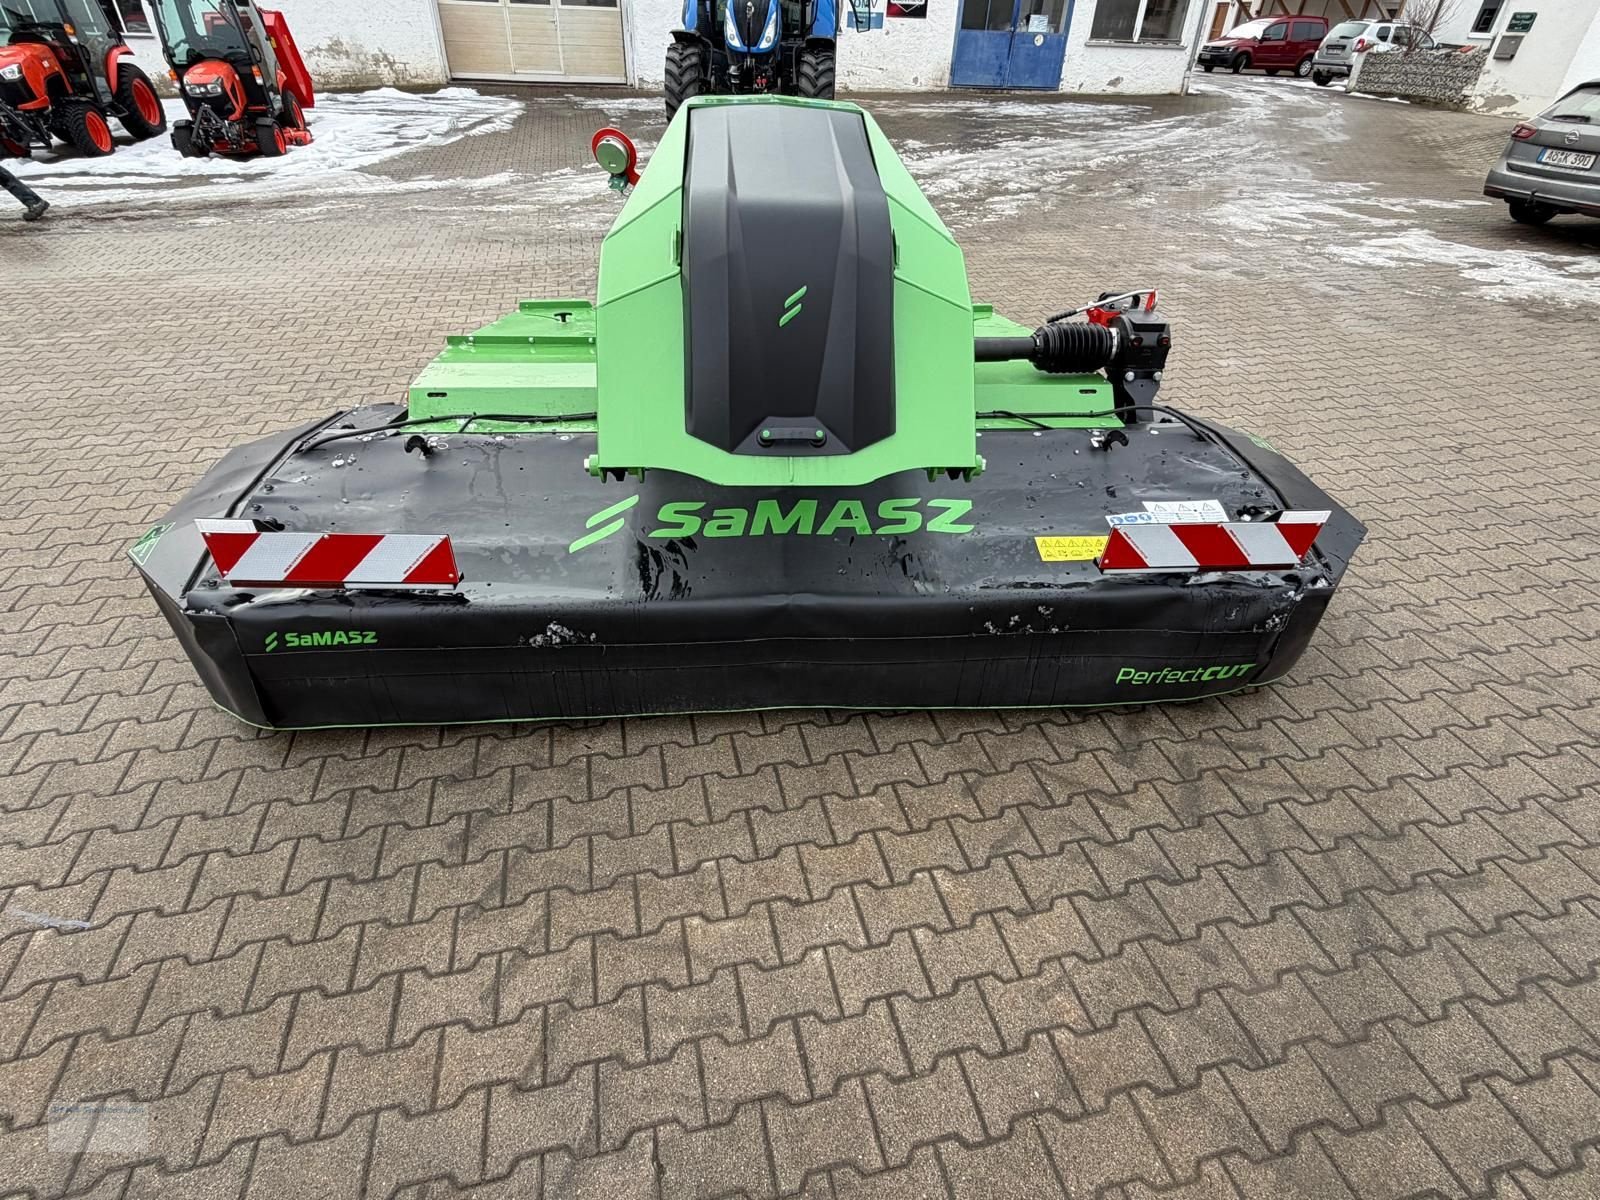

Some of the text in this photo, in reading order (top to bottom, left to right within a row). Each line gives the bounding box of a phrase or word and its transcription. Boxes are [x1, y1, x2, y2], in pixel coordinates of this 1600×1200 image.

[1571, 154, 1591, 166] 390
[648, 498, 975, 538] SaMASZ
[285, 631, 378, 647] SaMASZ
[1115, 663, 1257, 685] PerfectCUT
